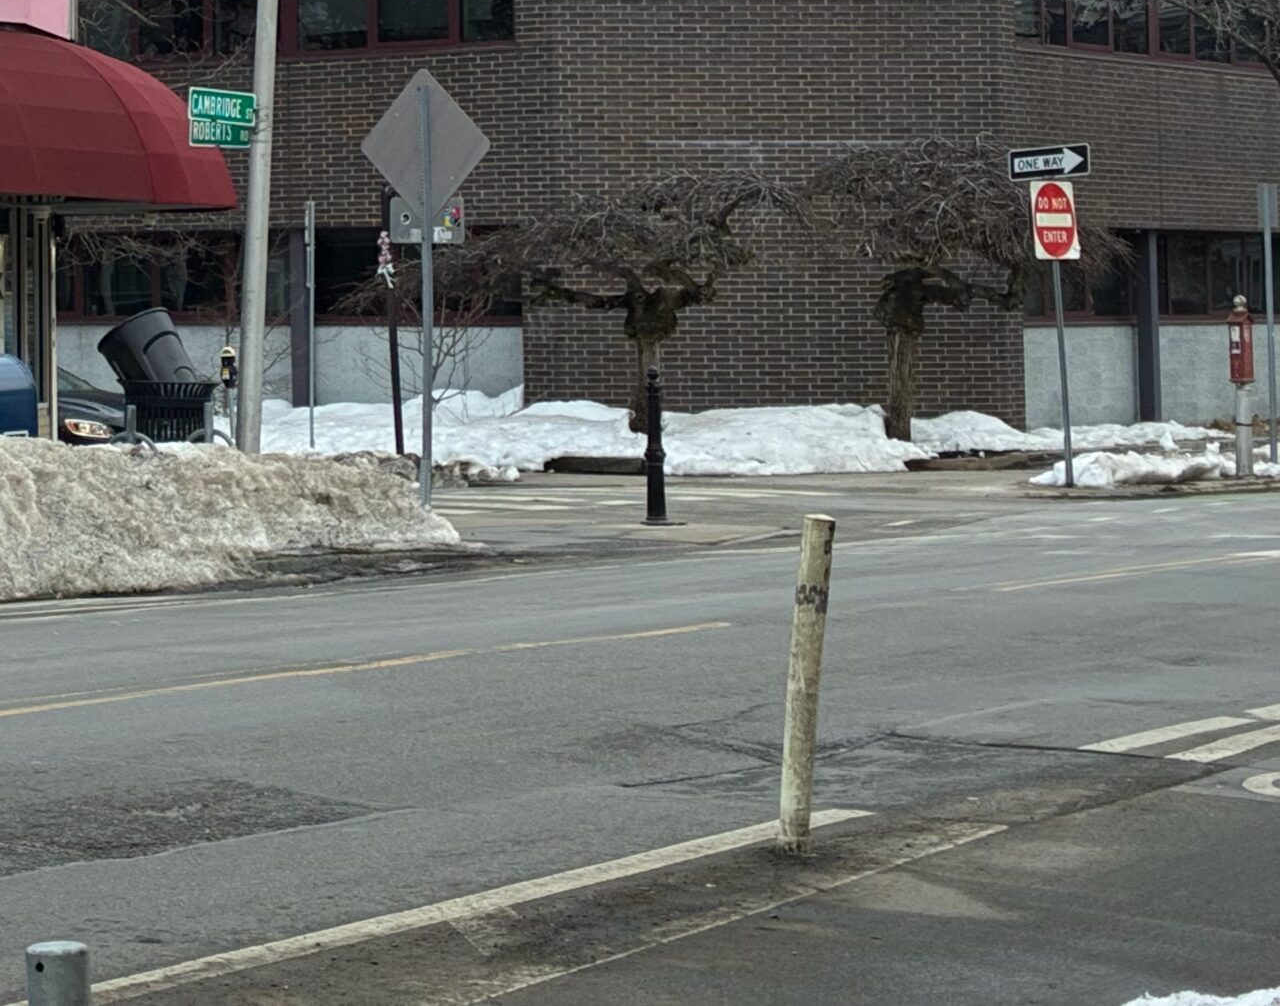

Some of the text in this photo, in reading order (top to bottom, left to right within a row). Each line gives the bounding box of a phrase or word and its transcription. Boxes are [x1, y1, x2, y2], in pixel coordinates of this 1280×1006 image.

[192, 93, 242, 119] CAMBRIDGE
[192, 121, 233, 142] ROBERTS
[1017, 156, 1065, 171] ONE WAY
[1037, 197, 1067, 210] DO NOT
[1043, 229, 1068, 243] ENTER
